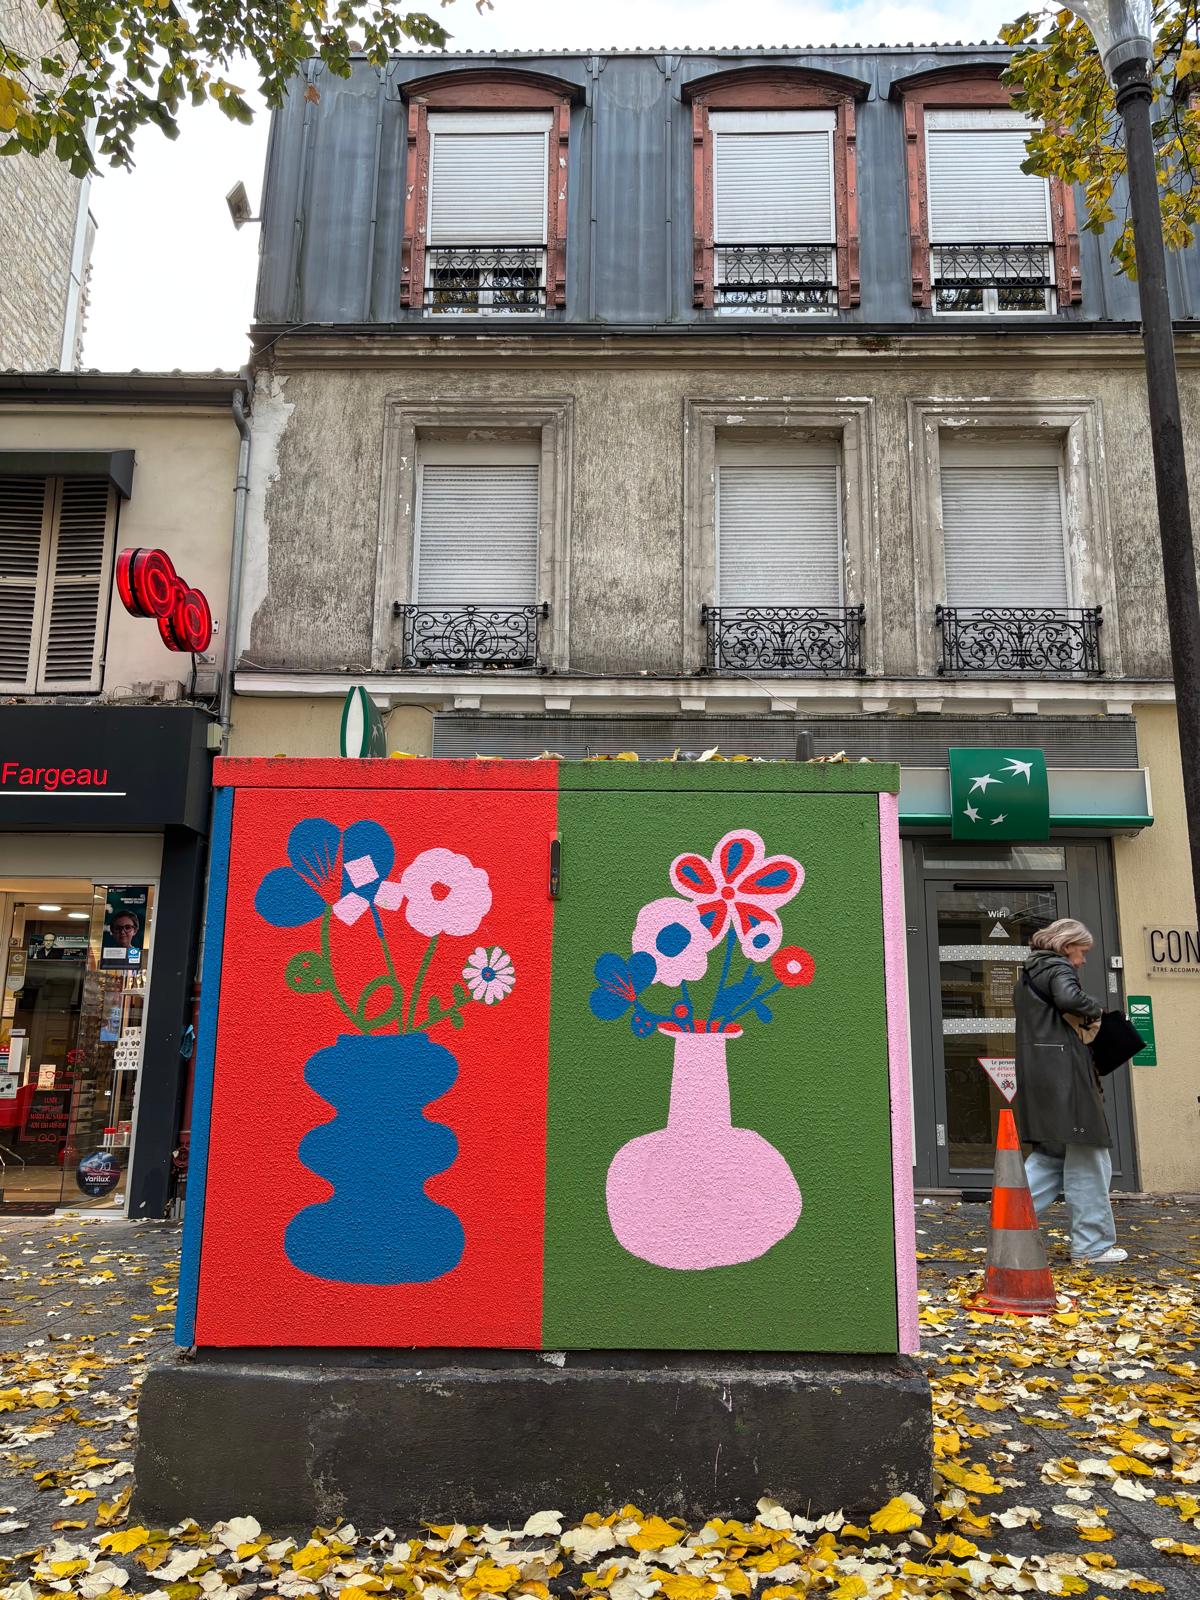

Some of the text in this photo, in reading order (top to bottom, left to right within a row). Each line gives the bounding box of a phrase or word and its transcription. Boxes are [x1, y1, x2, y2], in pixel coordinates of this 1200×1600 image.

[1, 762, 108, 791] Fargeau
[987, 910, 1006, 918] WiFi
[1150, 929, 1200, 963] CON
[1152, 965, 1169, 973] ÊTRE
